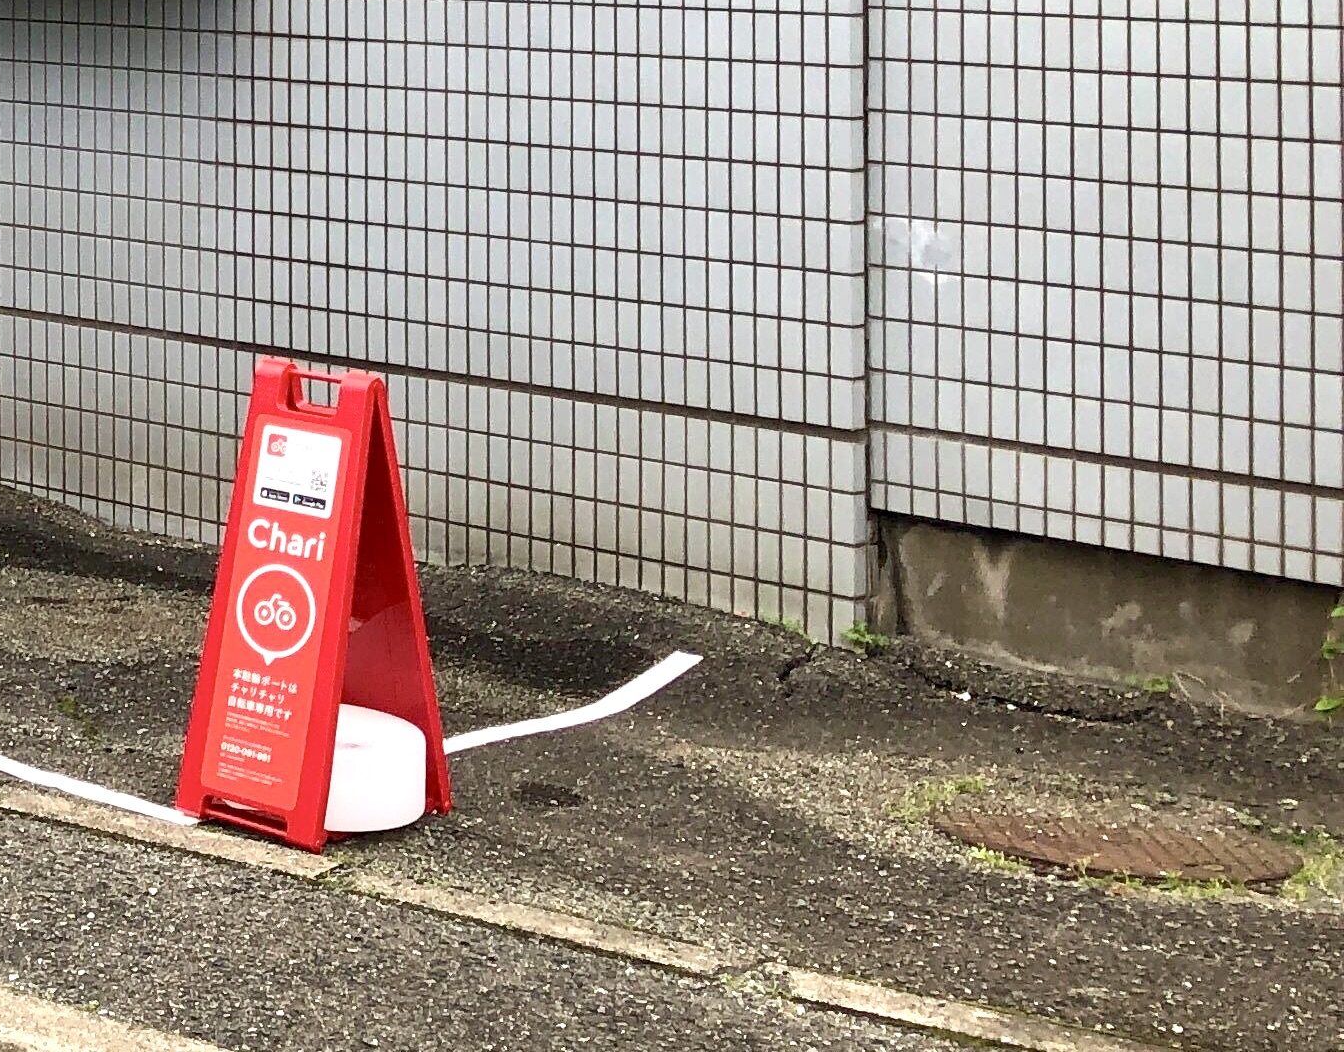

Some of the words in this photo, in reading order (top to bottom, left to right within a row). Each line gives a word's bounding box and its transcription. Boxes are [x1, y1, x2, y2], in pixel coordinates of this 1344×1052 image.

[247, 518, 327, 562] Chari
[230, 682, 285, 705] チャリチャリ
[232, 667, 298, 695] 本駐輪ポートは
[227, 694, 293, 722] 自転車専用です
